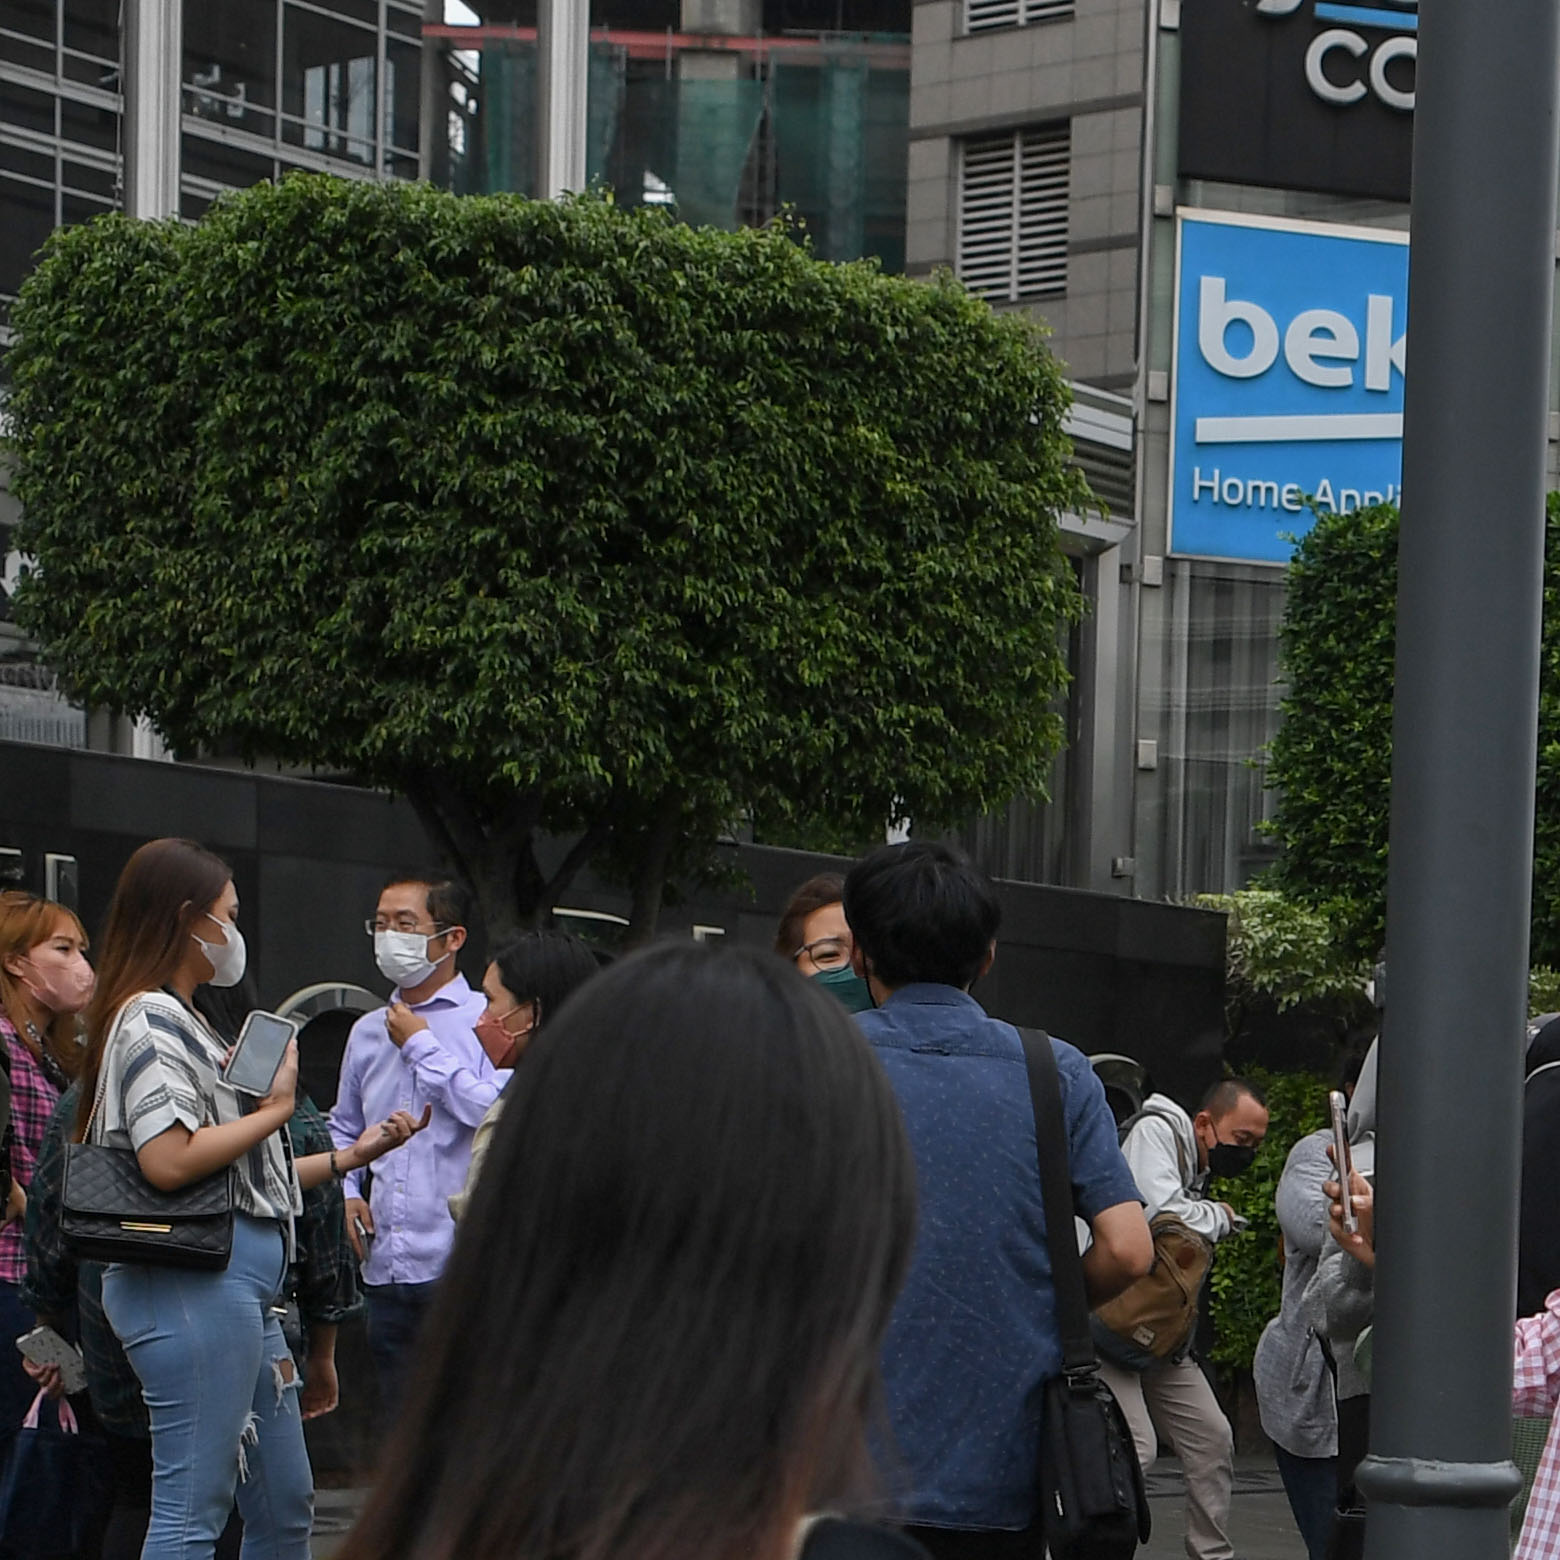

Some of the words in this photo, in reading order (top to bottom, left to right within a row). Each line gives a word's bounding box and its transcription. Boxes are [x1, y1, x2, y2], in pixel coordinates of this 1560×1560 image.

[1305, 28, 1418, 110] CO
[1198, 276, 1406, 392] bek
[1193, 467, 1301, 511] Home
[1315, 479, 1401, 516] Appli
